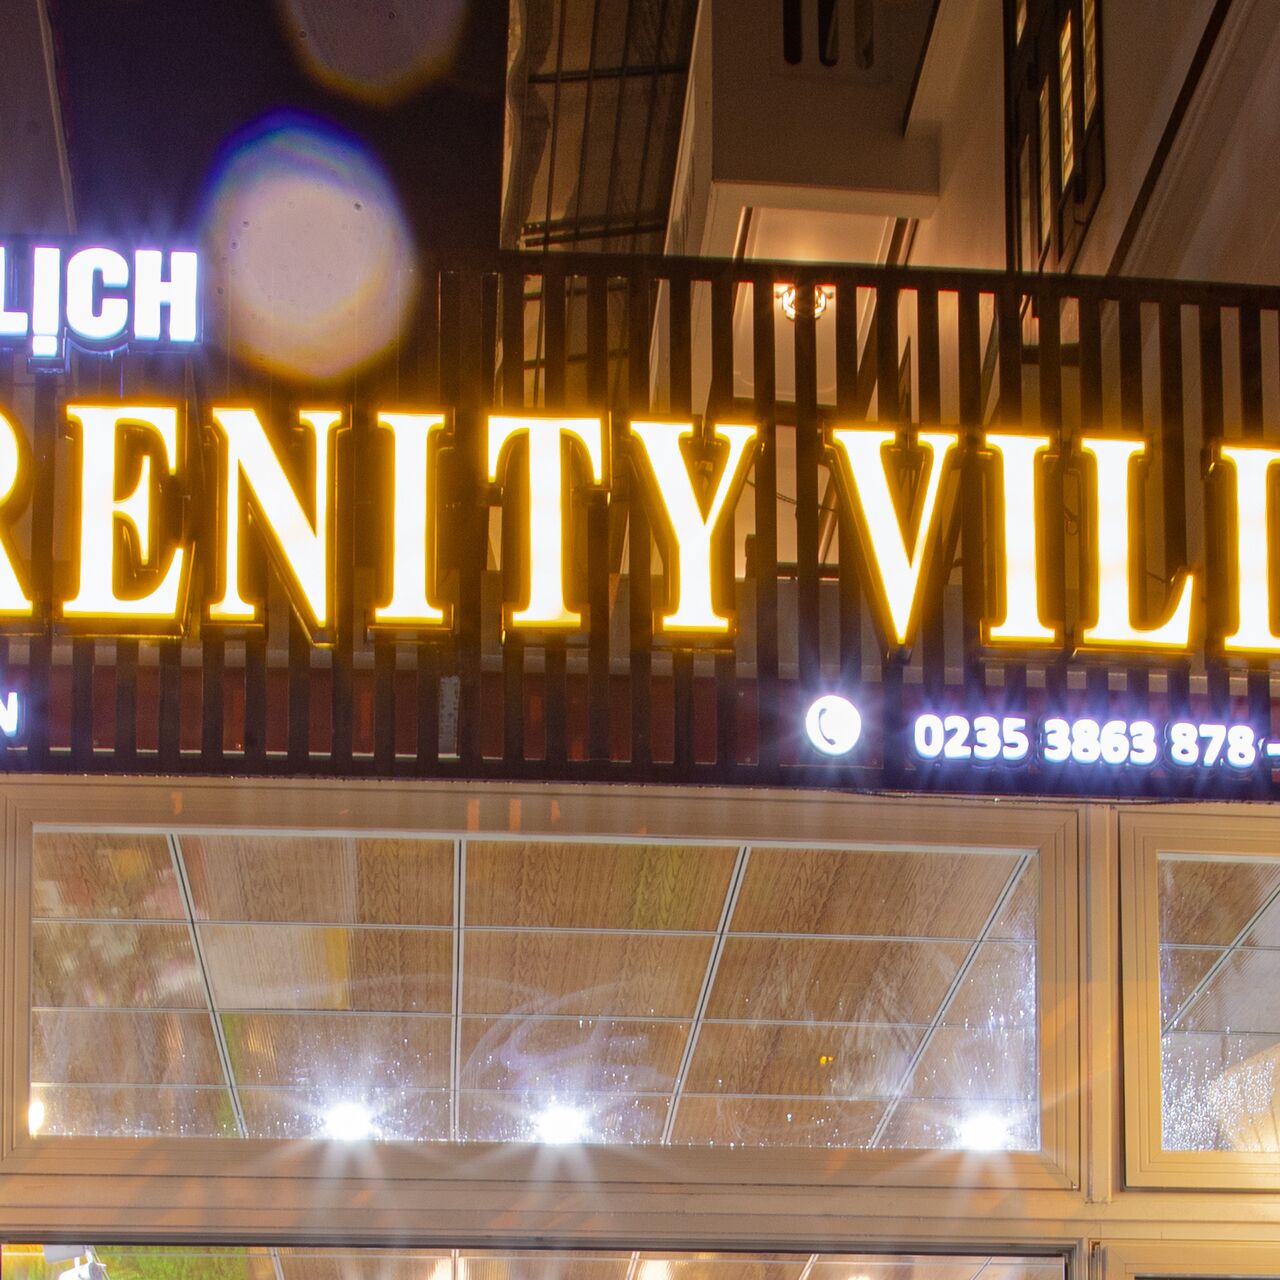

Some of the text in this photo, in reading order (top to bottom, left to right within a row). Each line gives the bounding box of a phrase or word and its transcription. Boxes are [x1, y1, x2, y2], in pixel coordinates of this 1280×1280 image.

[913, 714, 1029, 758] 0235
[1044, 718, 1157, 764] 3863
[1171, 722, 1256, 766] 878
